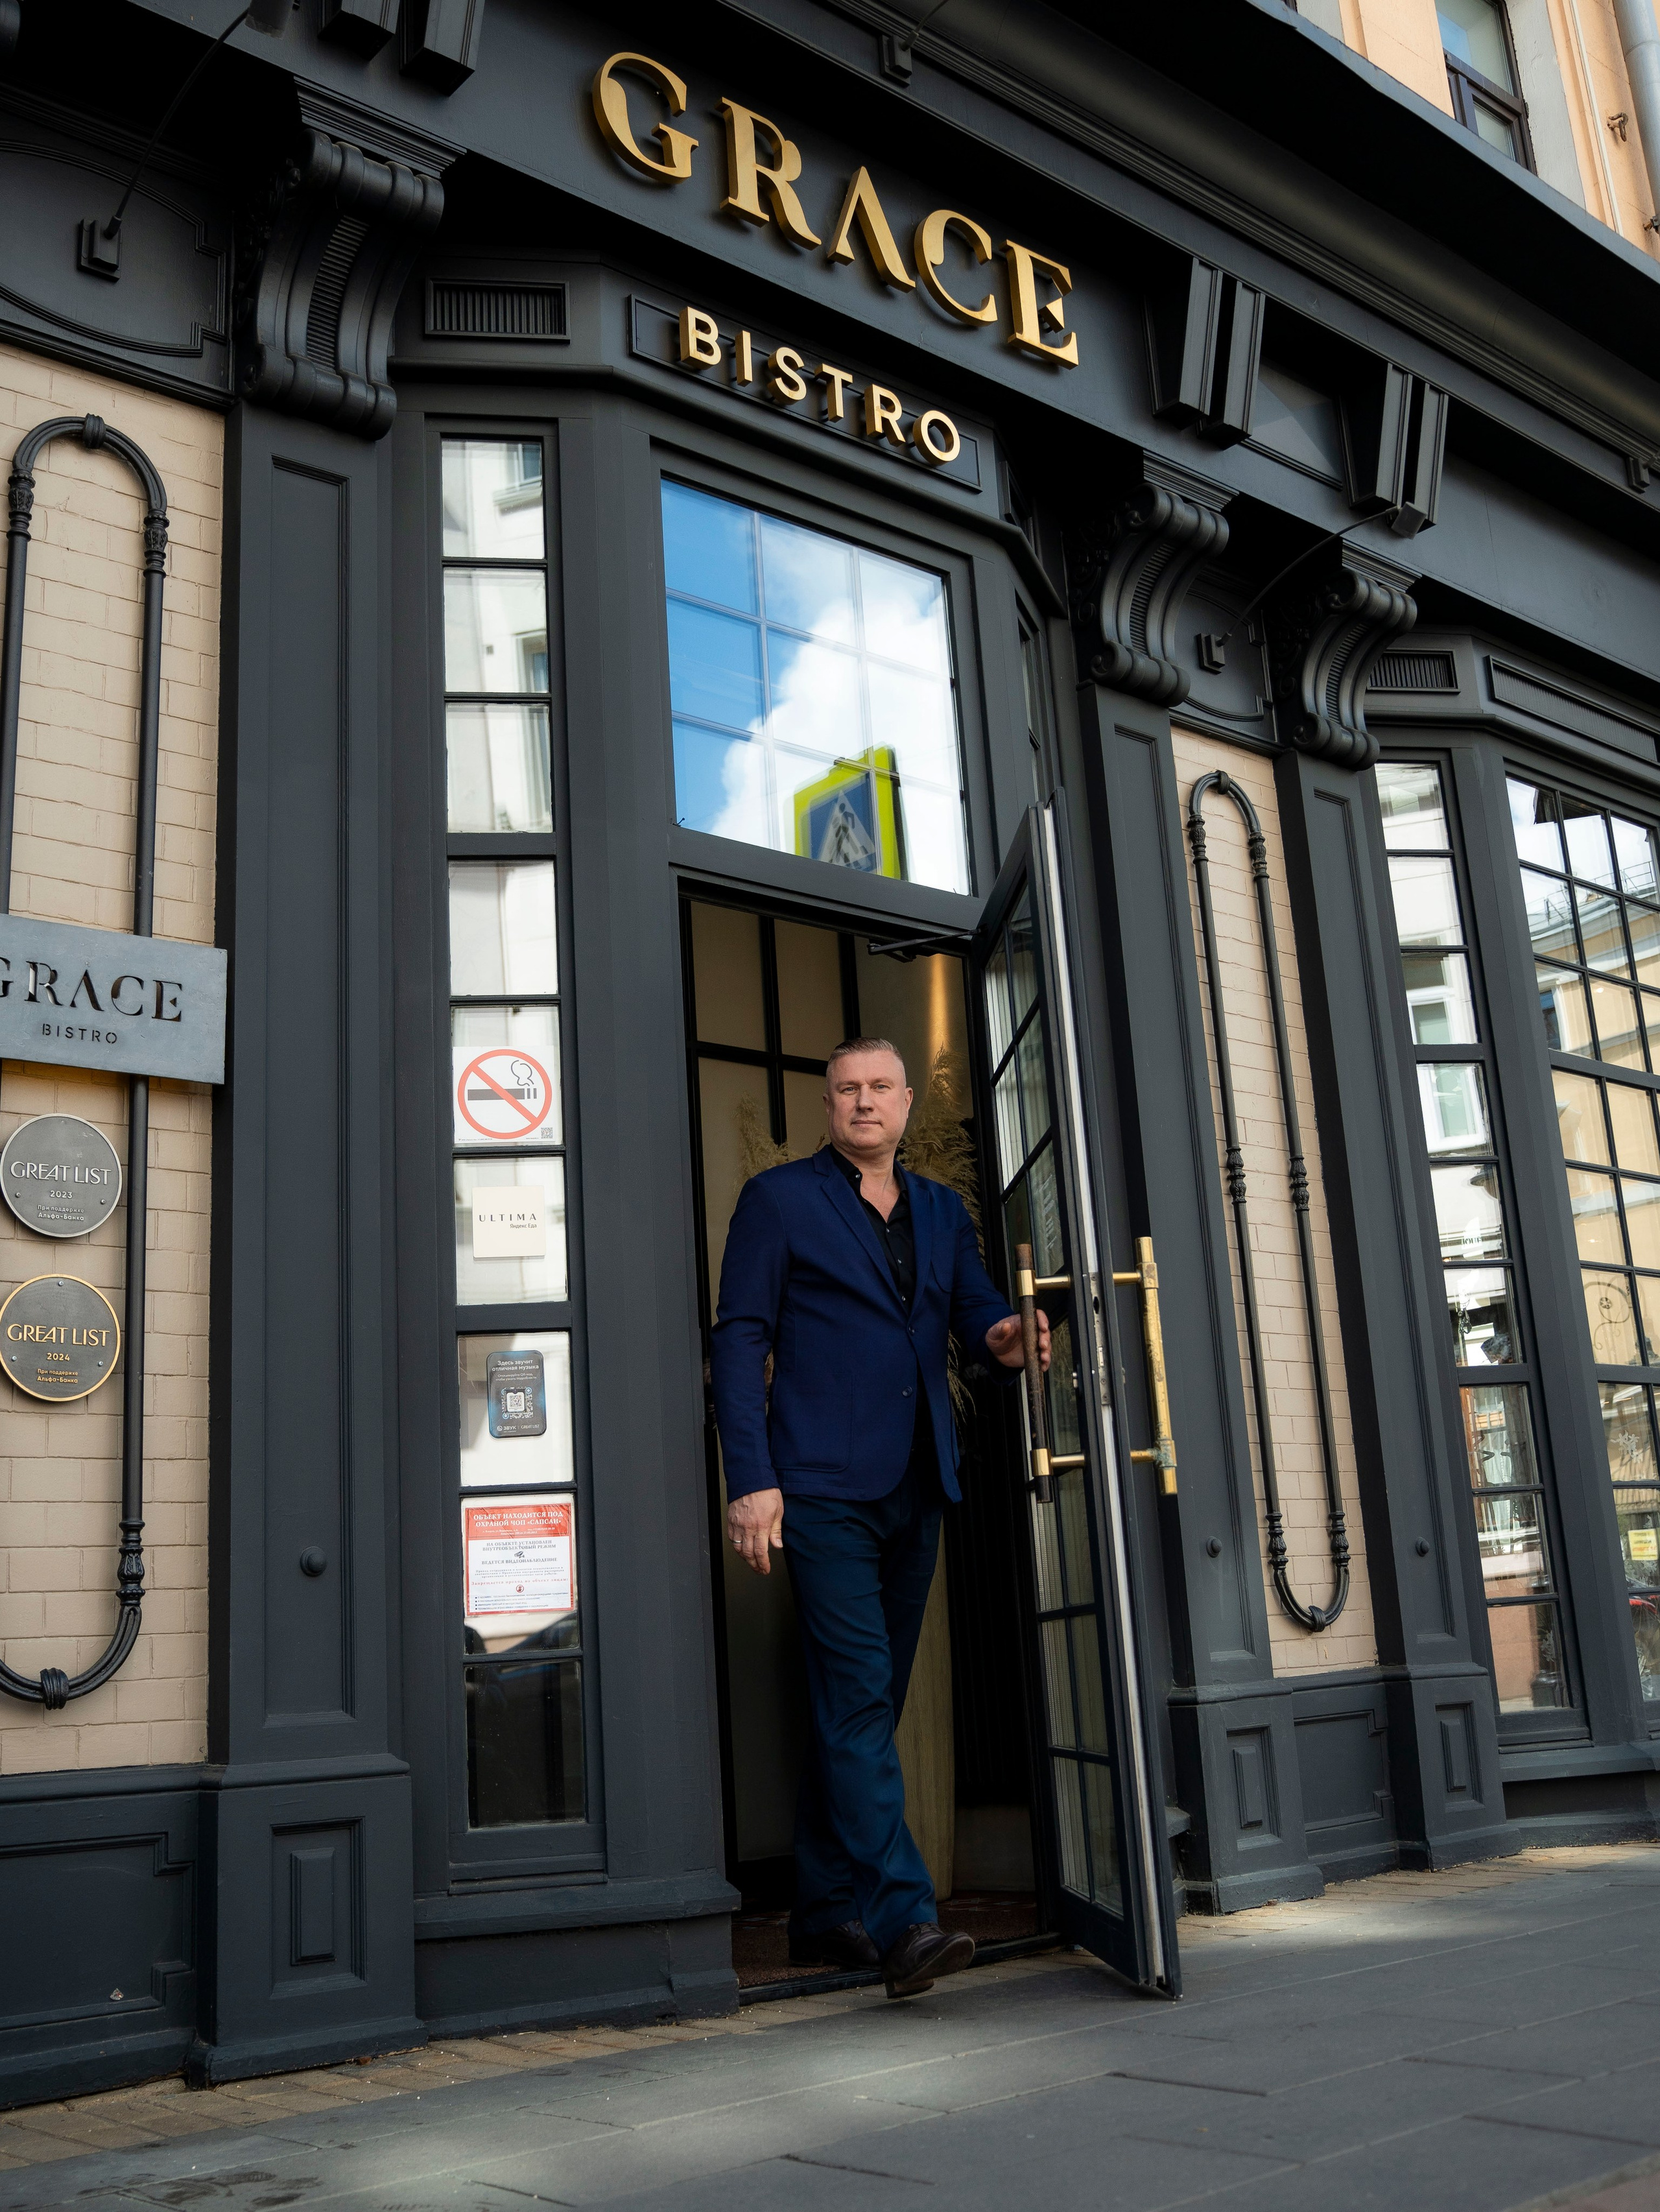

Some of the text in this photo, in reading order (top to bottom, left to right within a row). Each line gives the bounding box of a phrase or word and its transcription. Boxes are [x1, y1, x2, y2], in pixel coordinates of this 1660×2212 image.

[591, 51, 1080, 370] GRACE
[679, 305, 961, 466] BISTRO
[42, 1023, 118, 1045] BISTRO
[10, 1161, 112, 1185] GREAT LIST
[50, 1190, 73, 1199] 2023
[38, 1212, 84, 1221] Альфа-Банка
[479, 1213, 536, 1222] ULTIMA
[7, 1324, 110, 1347] GREAT LIST
[47, 1353, 71, 1361] 2024
